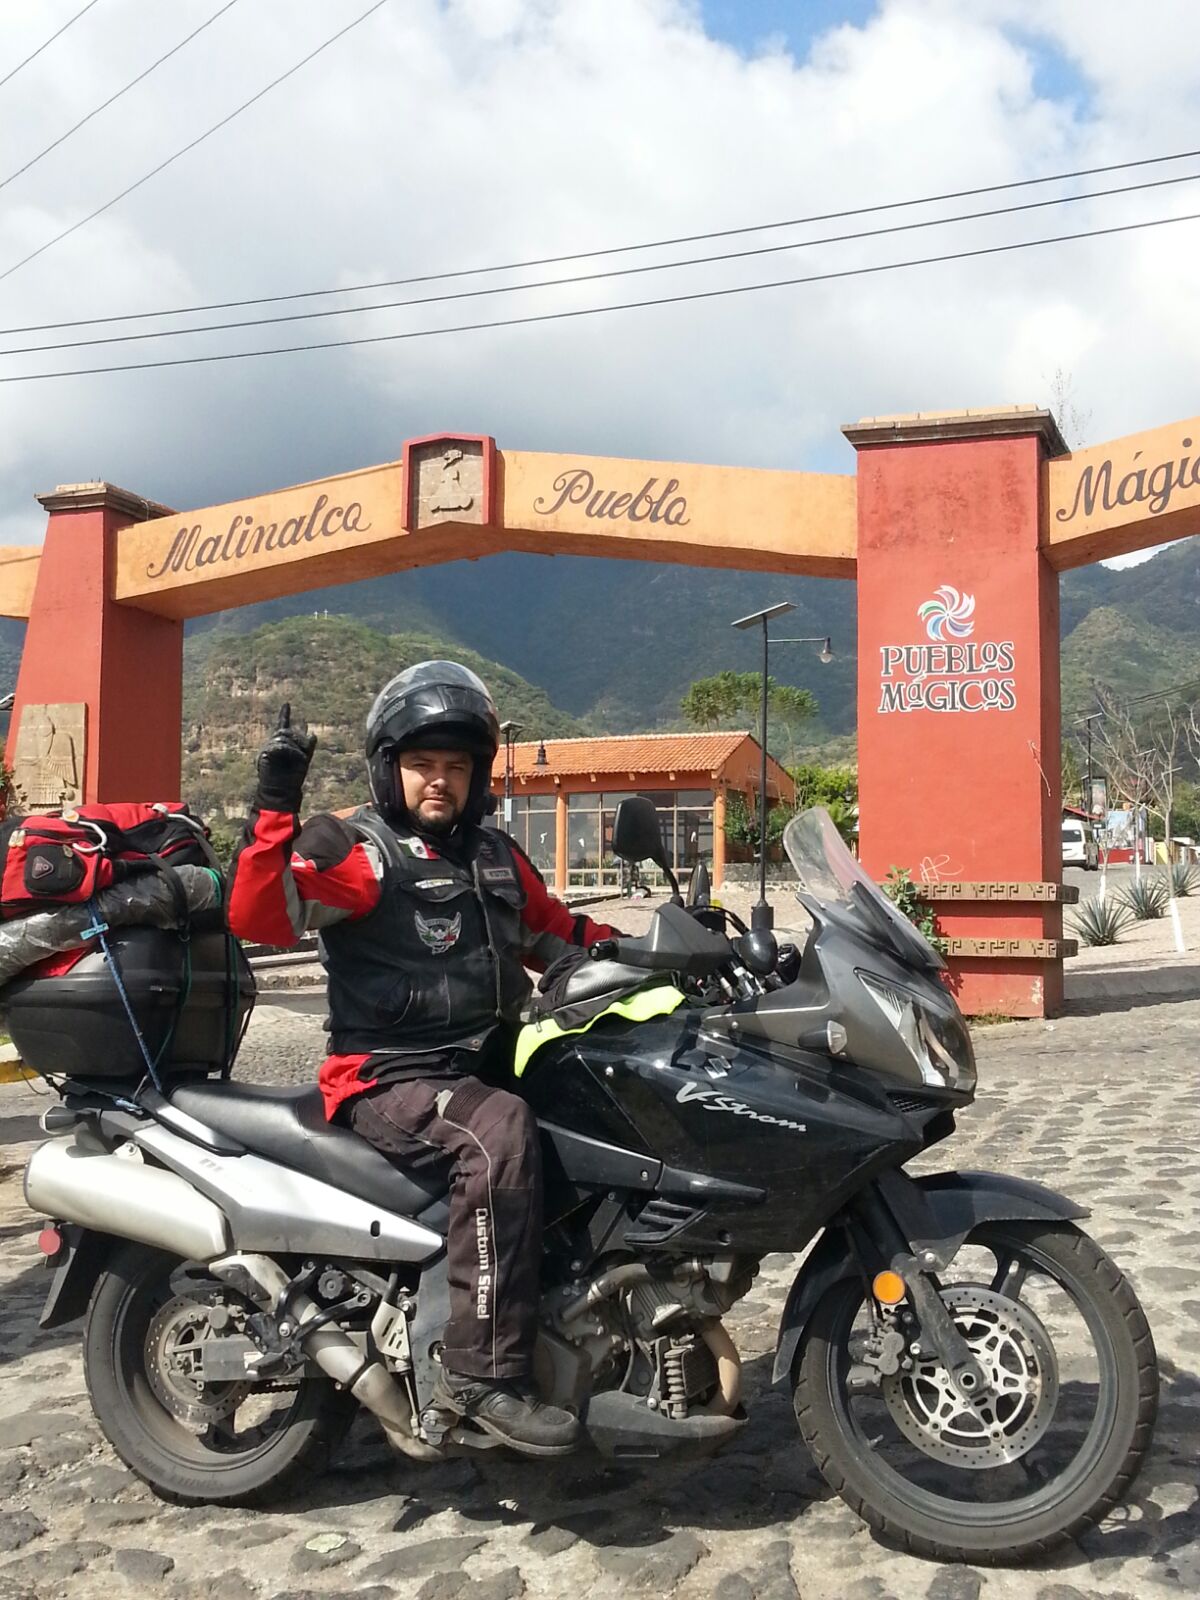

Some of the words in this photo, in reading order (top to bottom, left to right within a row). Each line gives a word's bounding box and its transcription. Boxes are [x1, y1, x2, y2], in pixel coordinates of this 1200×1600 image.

[533, 469, 690, 526] Pueblo
[147, 494, 372, 578] Malinalco
[475, 1208, 489, 1271] Custom
[477, 1275, 491, 1320] Steel
